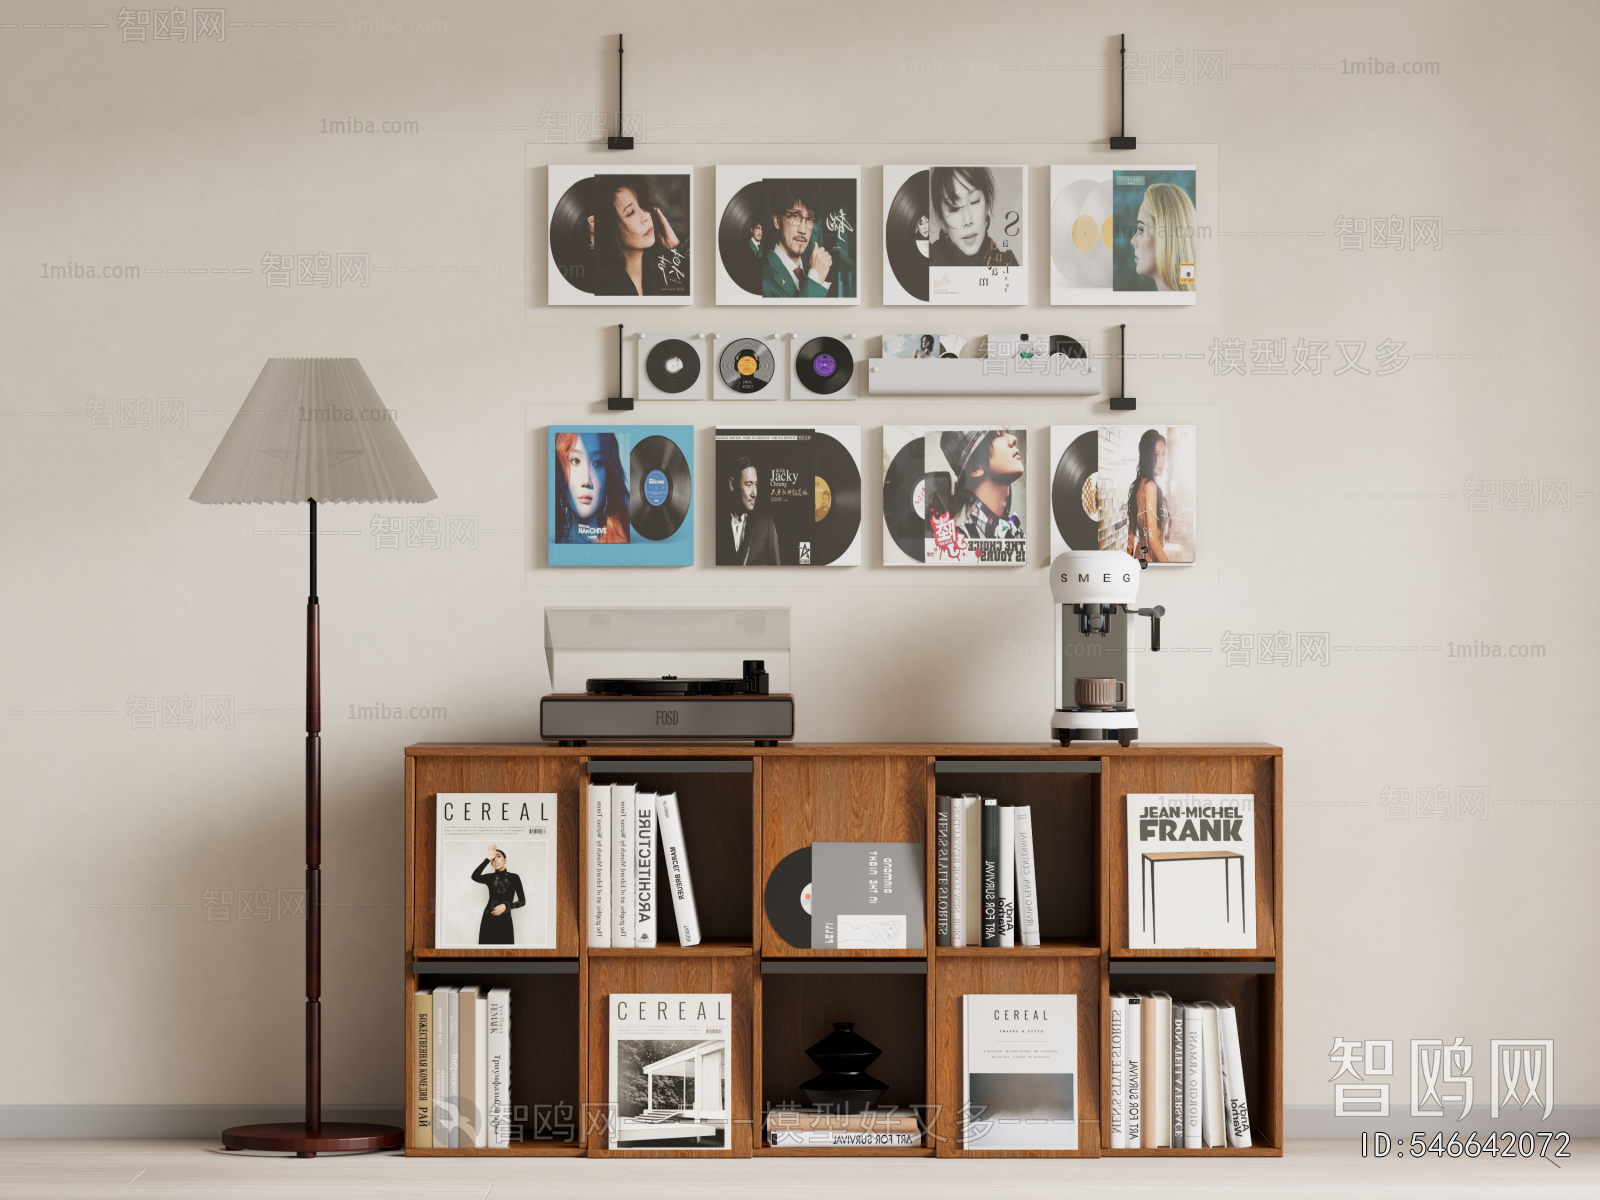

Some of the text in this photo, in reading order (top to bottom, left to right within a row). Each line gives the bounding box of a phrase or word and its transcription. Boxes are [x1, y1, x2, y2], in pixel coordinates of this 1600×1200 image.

[770, 470, 798, 484] Jacky
[1060, 574, 1130, 582] SMEG
[656, 710, 678, 725] FOSD
[444, 802, 548, 821] CEREAL
[1140, 806, 1244, 818] JEAN-MICHEL
[1140, 819, 1244, 842] FRANK
[617, 1001, 725, 1021] CEREAL
[994, 1010, 1048, 1020] CEREAL
[419, 1014, 430, 1127] БОЖЕСТВЕННАЯ КОМЕДИЯ РАЙ
